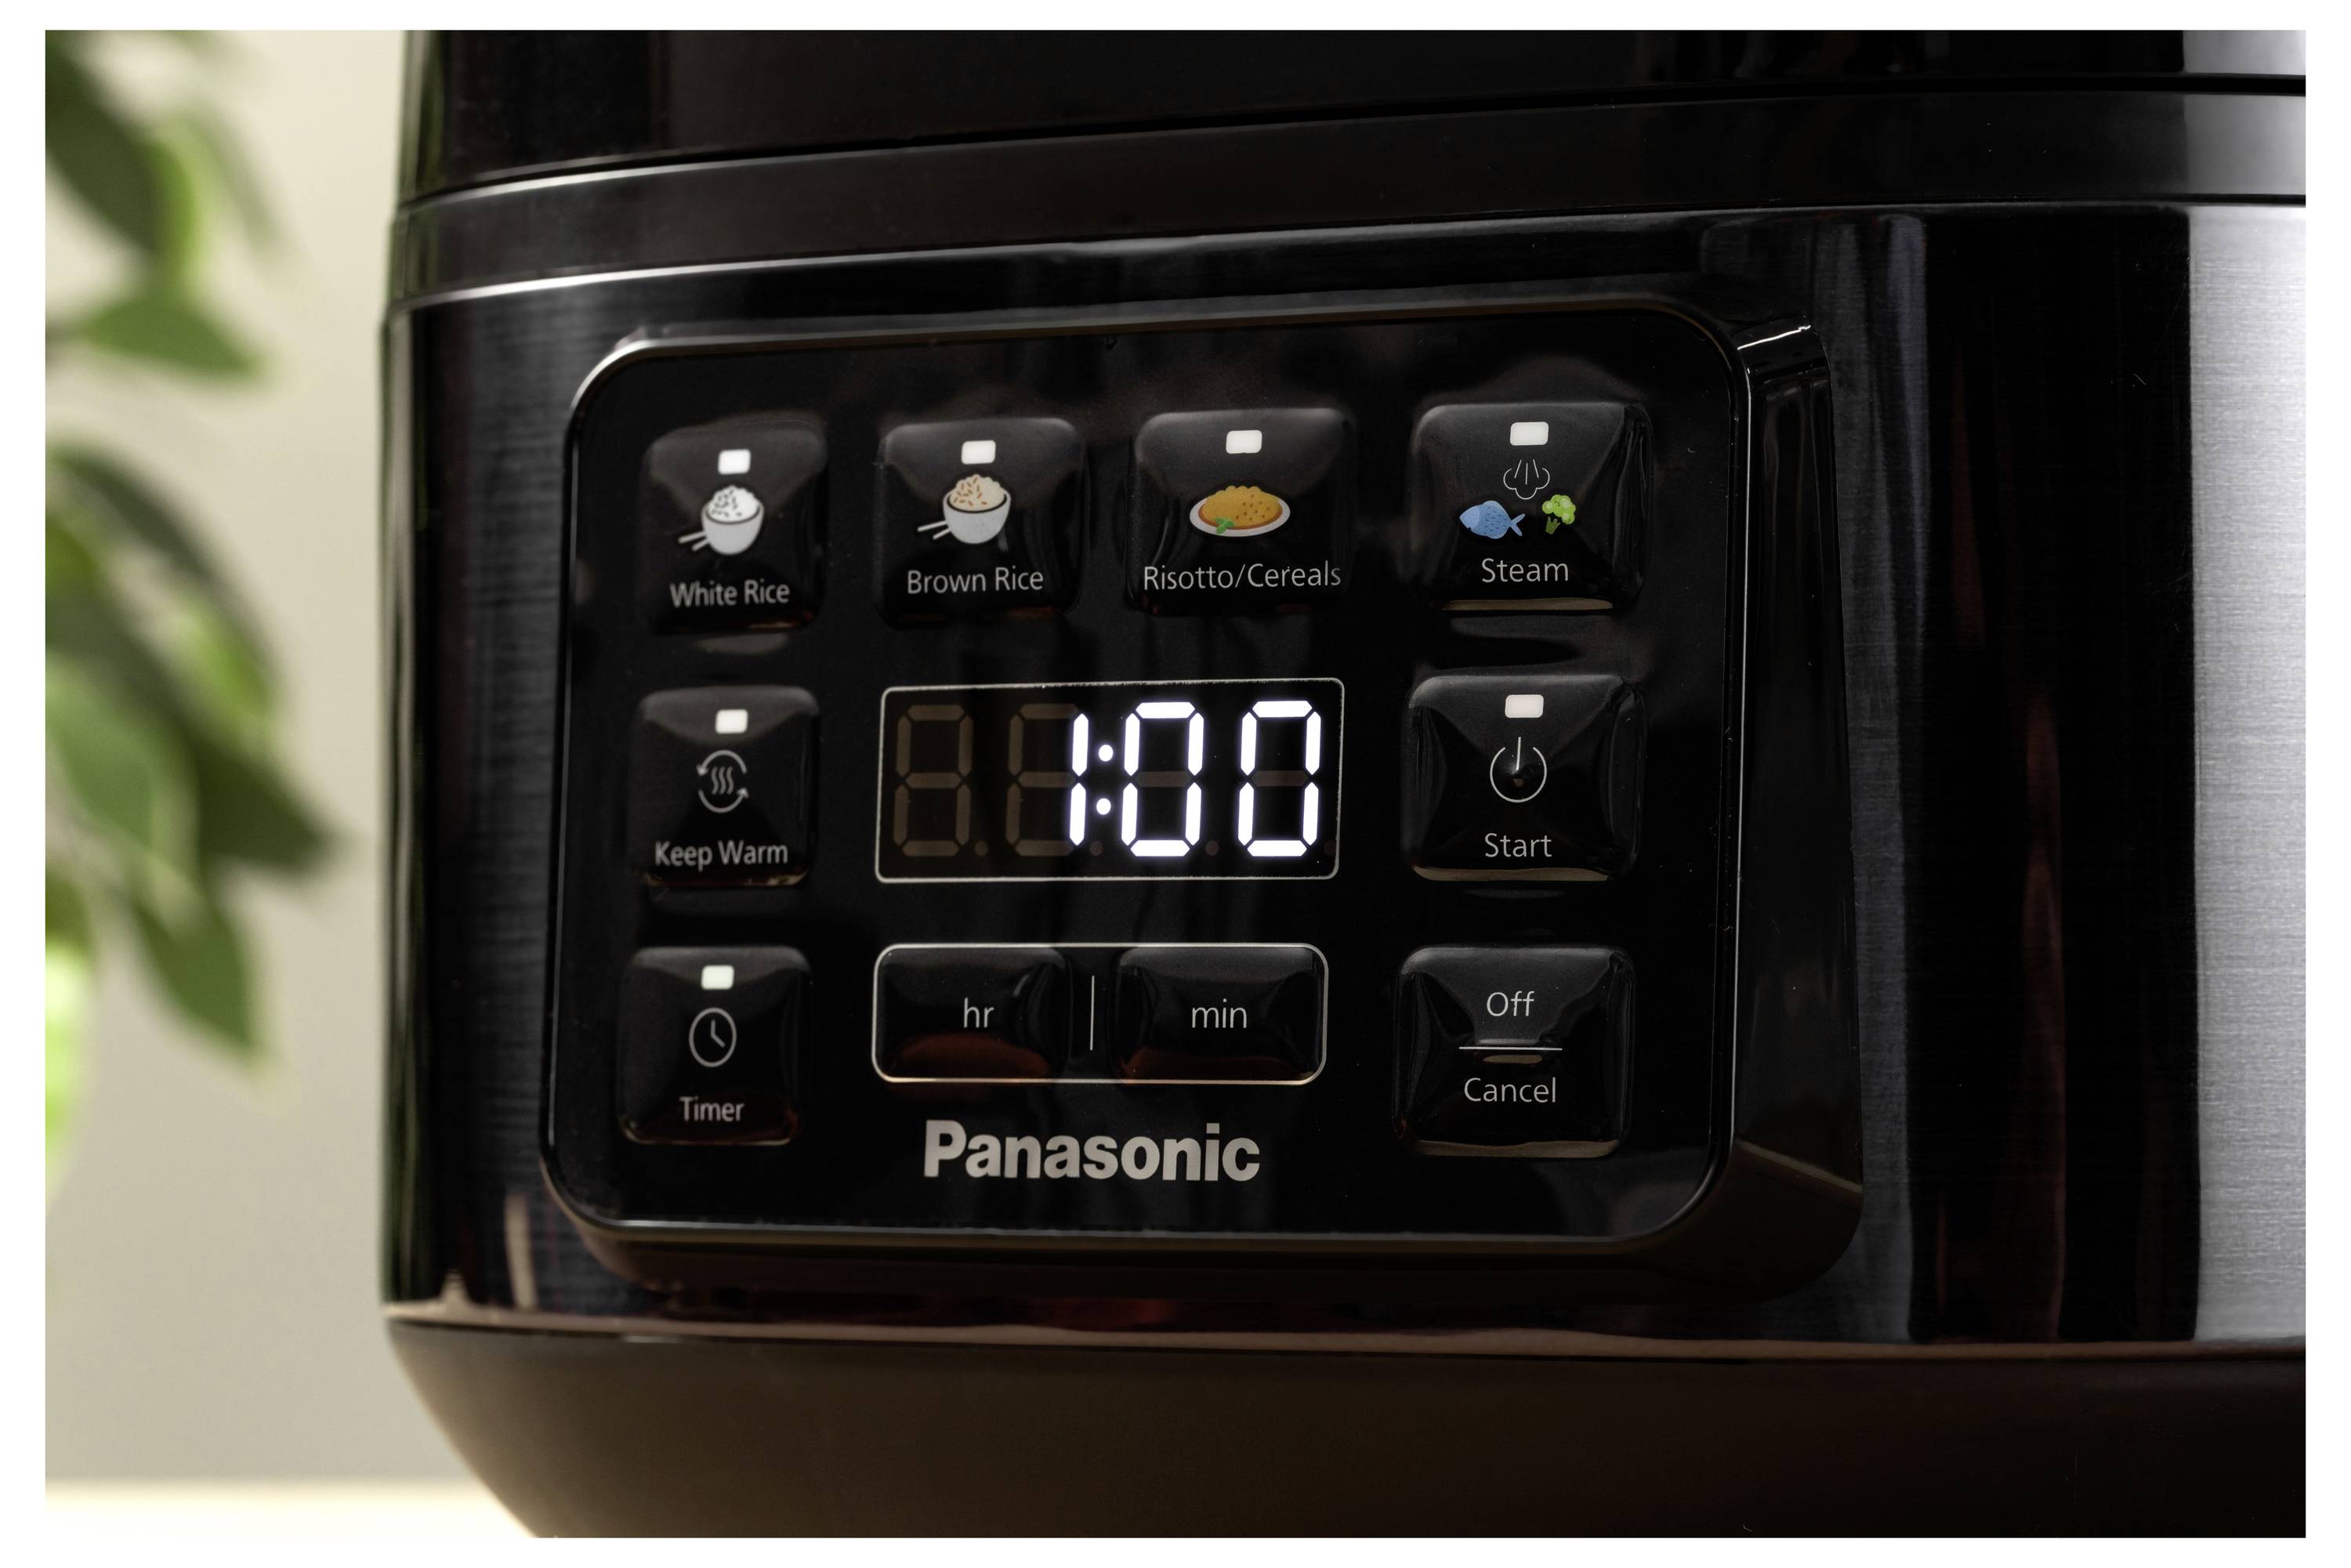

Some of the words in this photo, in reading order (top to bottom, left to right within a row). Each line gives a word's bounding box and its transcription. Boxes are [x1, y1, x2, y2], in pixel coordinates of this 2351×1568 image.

[907, 569, 987, 595] Brown
[994, 566, 1045, 592] Rice
[1143, 559, 1342, 591] Risotto/Cereals
[1480, 557, 1570, 584] Steam
[669, 582, 737, 607] White
[744, 579, 790, 603] Rice
[1069, 701, 1322, 857] 1:00
[655, 842, 713, 870] Keep
[718, 841, 788, 865] Warm
[1483, 831, 1553, 859] Start
[962, 997, 995, 1029] hr
[1191, 997, 1248, 1030] min
[1485, 990, 1537, 1018] Off
[1463, 1076, 1556, 1104] Cancel
[680, 1095, 744, 1122] Timer
[924, 1120, 1260, 1182] Panasonic
